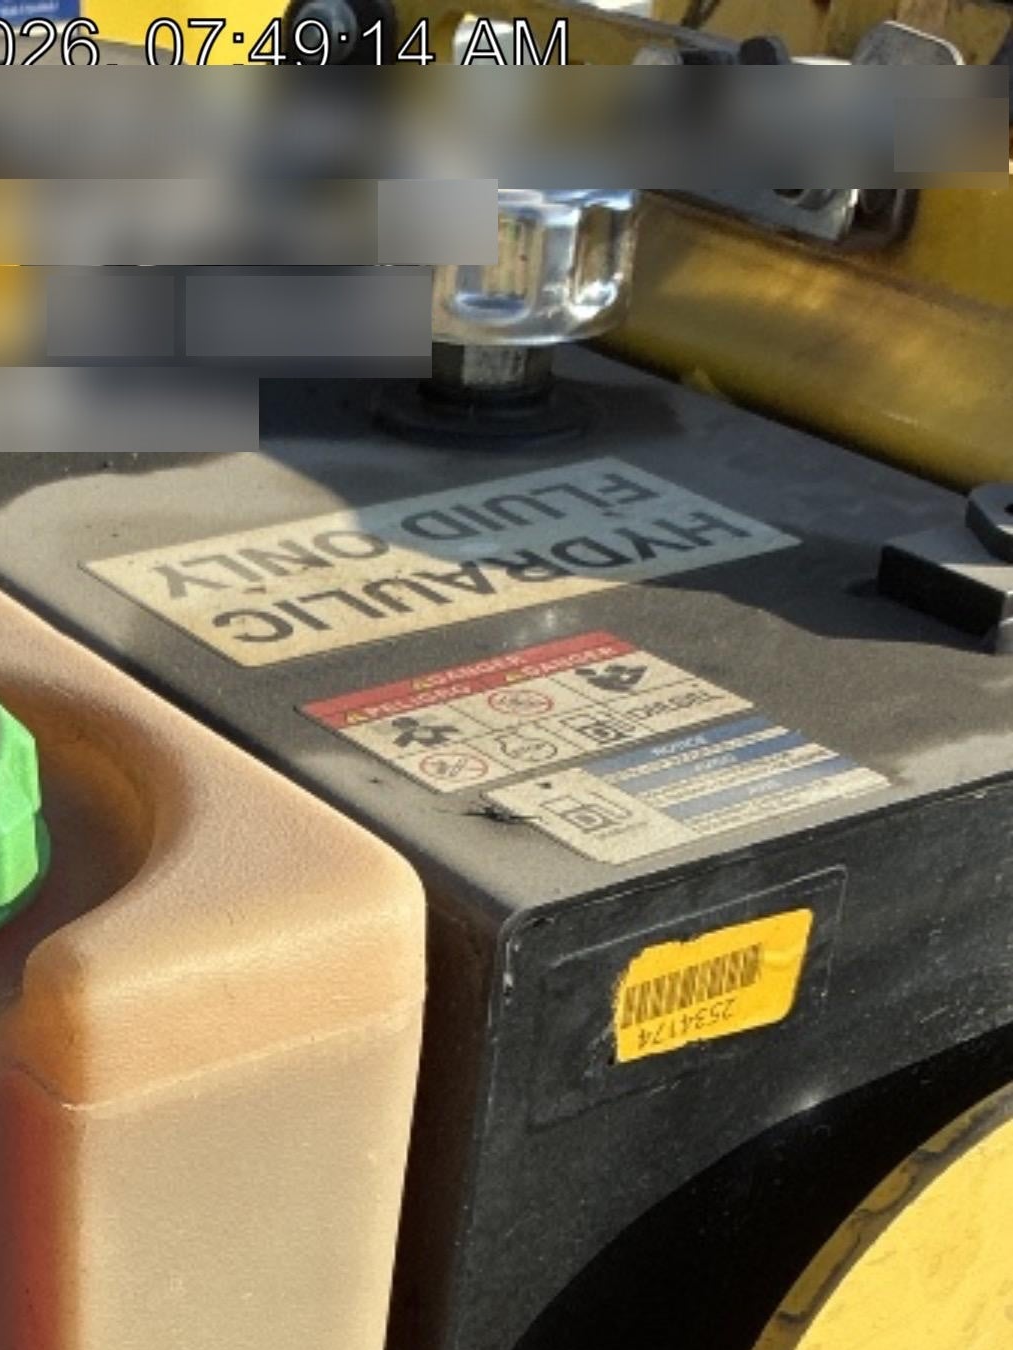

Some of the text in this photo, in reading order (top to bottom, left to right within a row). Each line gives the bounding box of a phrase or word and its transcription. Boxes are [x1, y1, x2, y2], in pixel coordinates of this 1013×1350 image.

[153, 472, 661, 601] FLUID ONLY
[212, 511, 754, 643] HYDRAULIC
[638, 998, 735, 1051] 2534174
